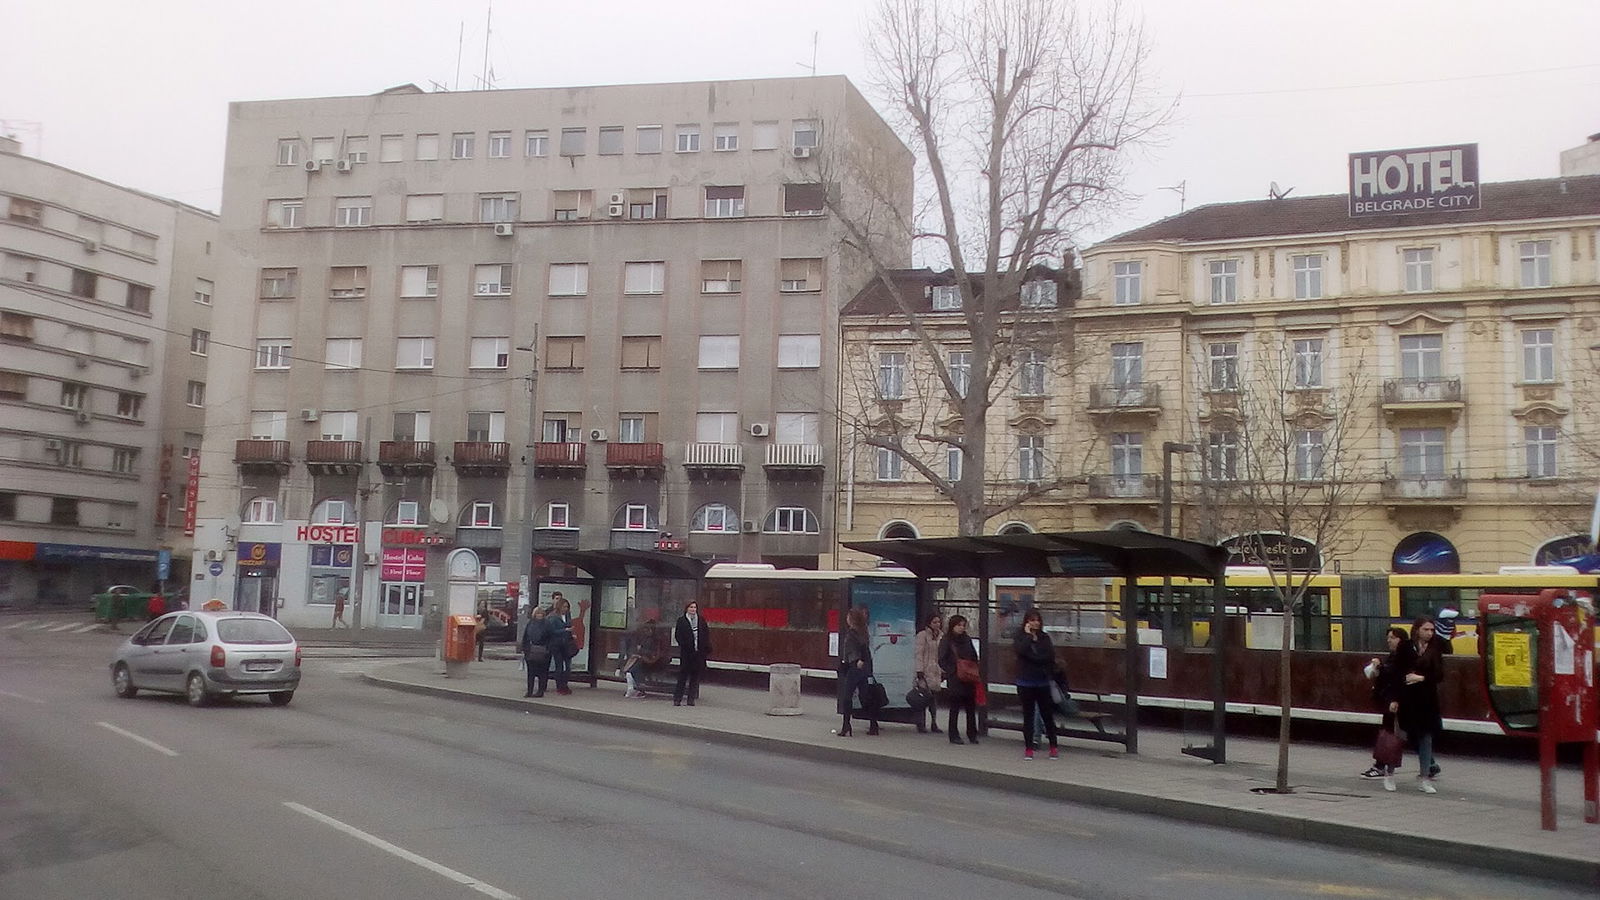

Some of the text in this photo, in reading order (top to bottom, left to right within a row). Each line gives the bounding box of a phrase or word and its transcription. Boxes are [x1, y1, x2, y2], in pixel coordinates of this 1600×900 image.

[1353, 149, 1475, 198] HOTEL
[1355, 195, 1474, 213] BELGRADE CITY
[297, 525, 360, 543] HOSTEL
[384, 553, 403, 561] Hostel
[1263, 541, 1307, 555] estoan
